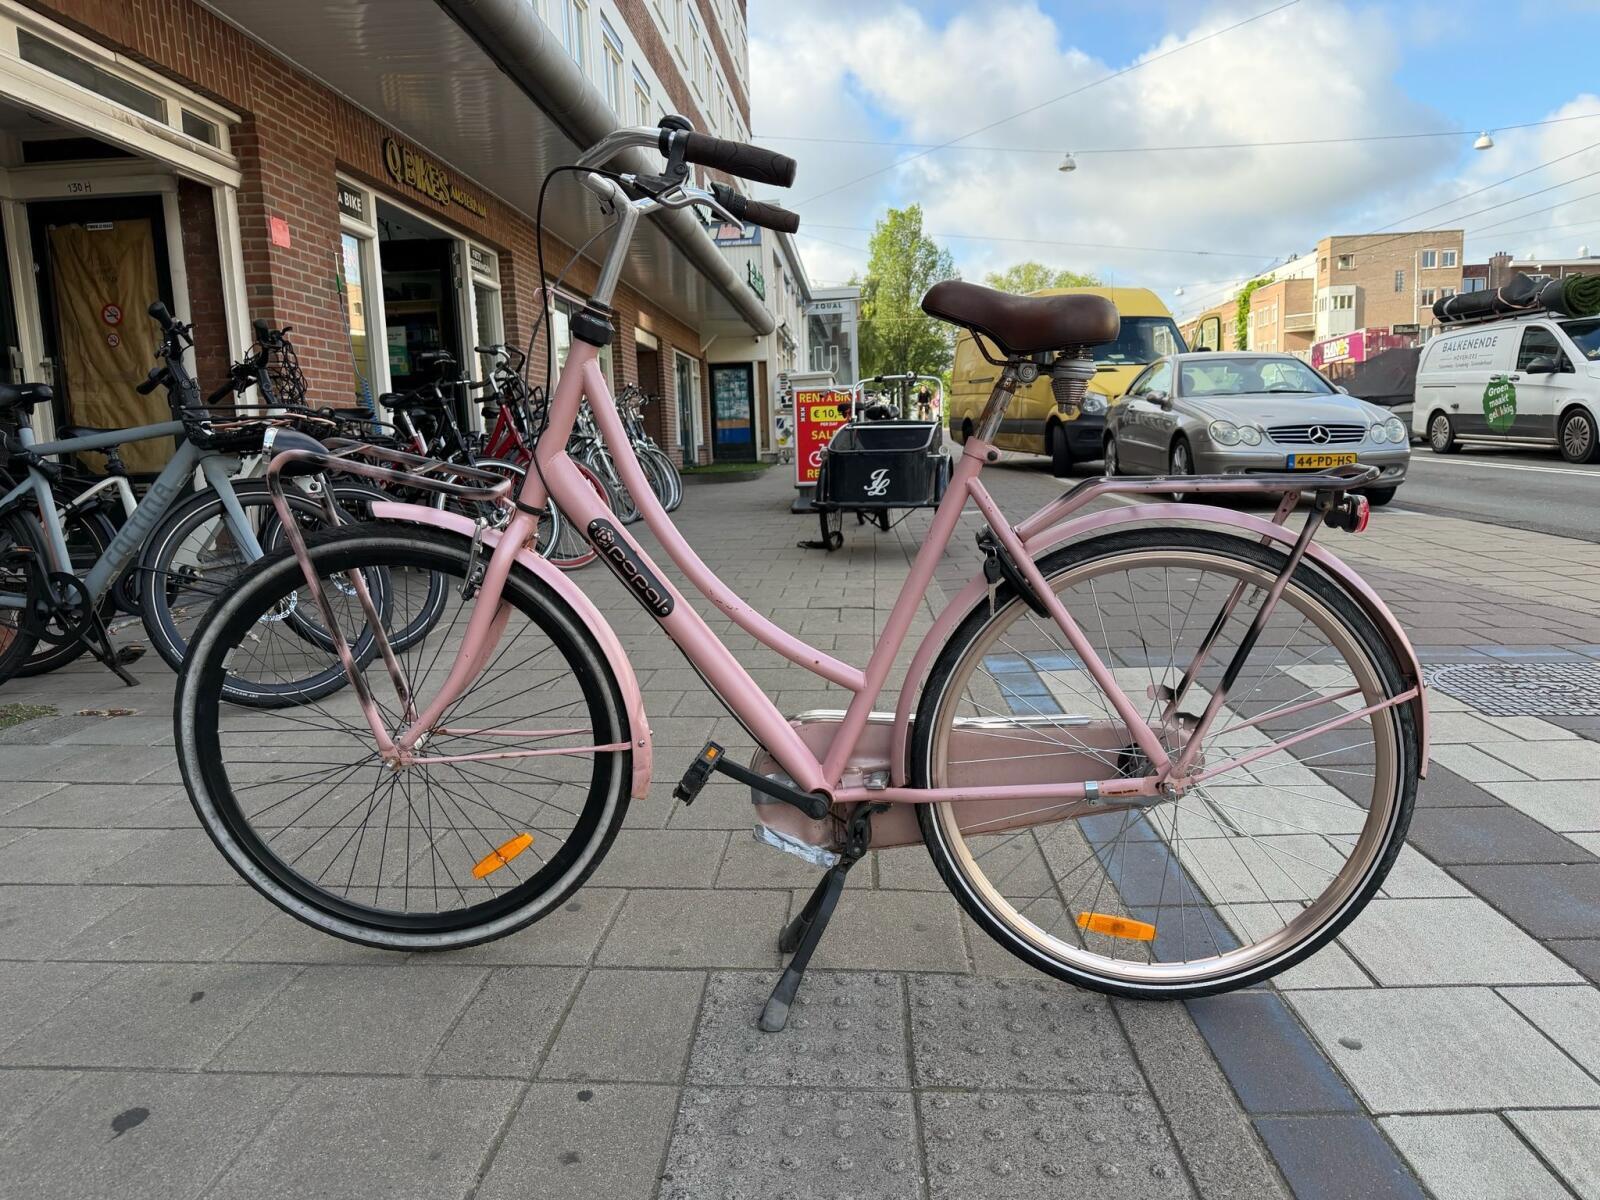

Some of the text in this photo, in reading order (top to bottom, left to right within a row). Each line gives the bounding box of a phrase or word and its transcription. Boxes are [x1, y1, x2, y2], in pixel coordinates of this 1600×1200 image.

[403, 148, 450, 206] BIKES
[68, 181, 92, 193] 130 H
[344, 191, 362, 212] BIKE
[1442, 336, 1498, 352] BALKENENDE
[1488, 384, 1509, 397] Groen
[1489, 394, 1509, 408] maakt
[814, 409, 820, 418] €
[1297, 455, 1353, 467] 44-PD-HS
[608, 546, 668, 608] popal
